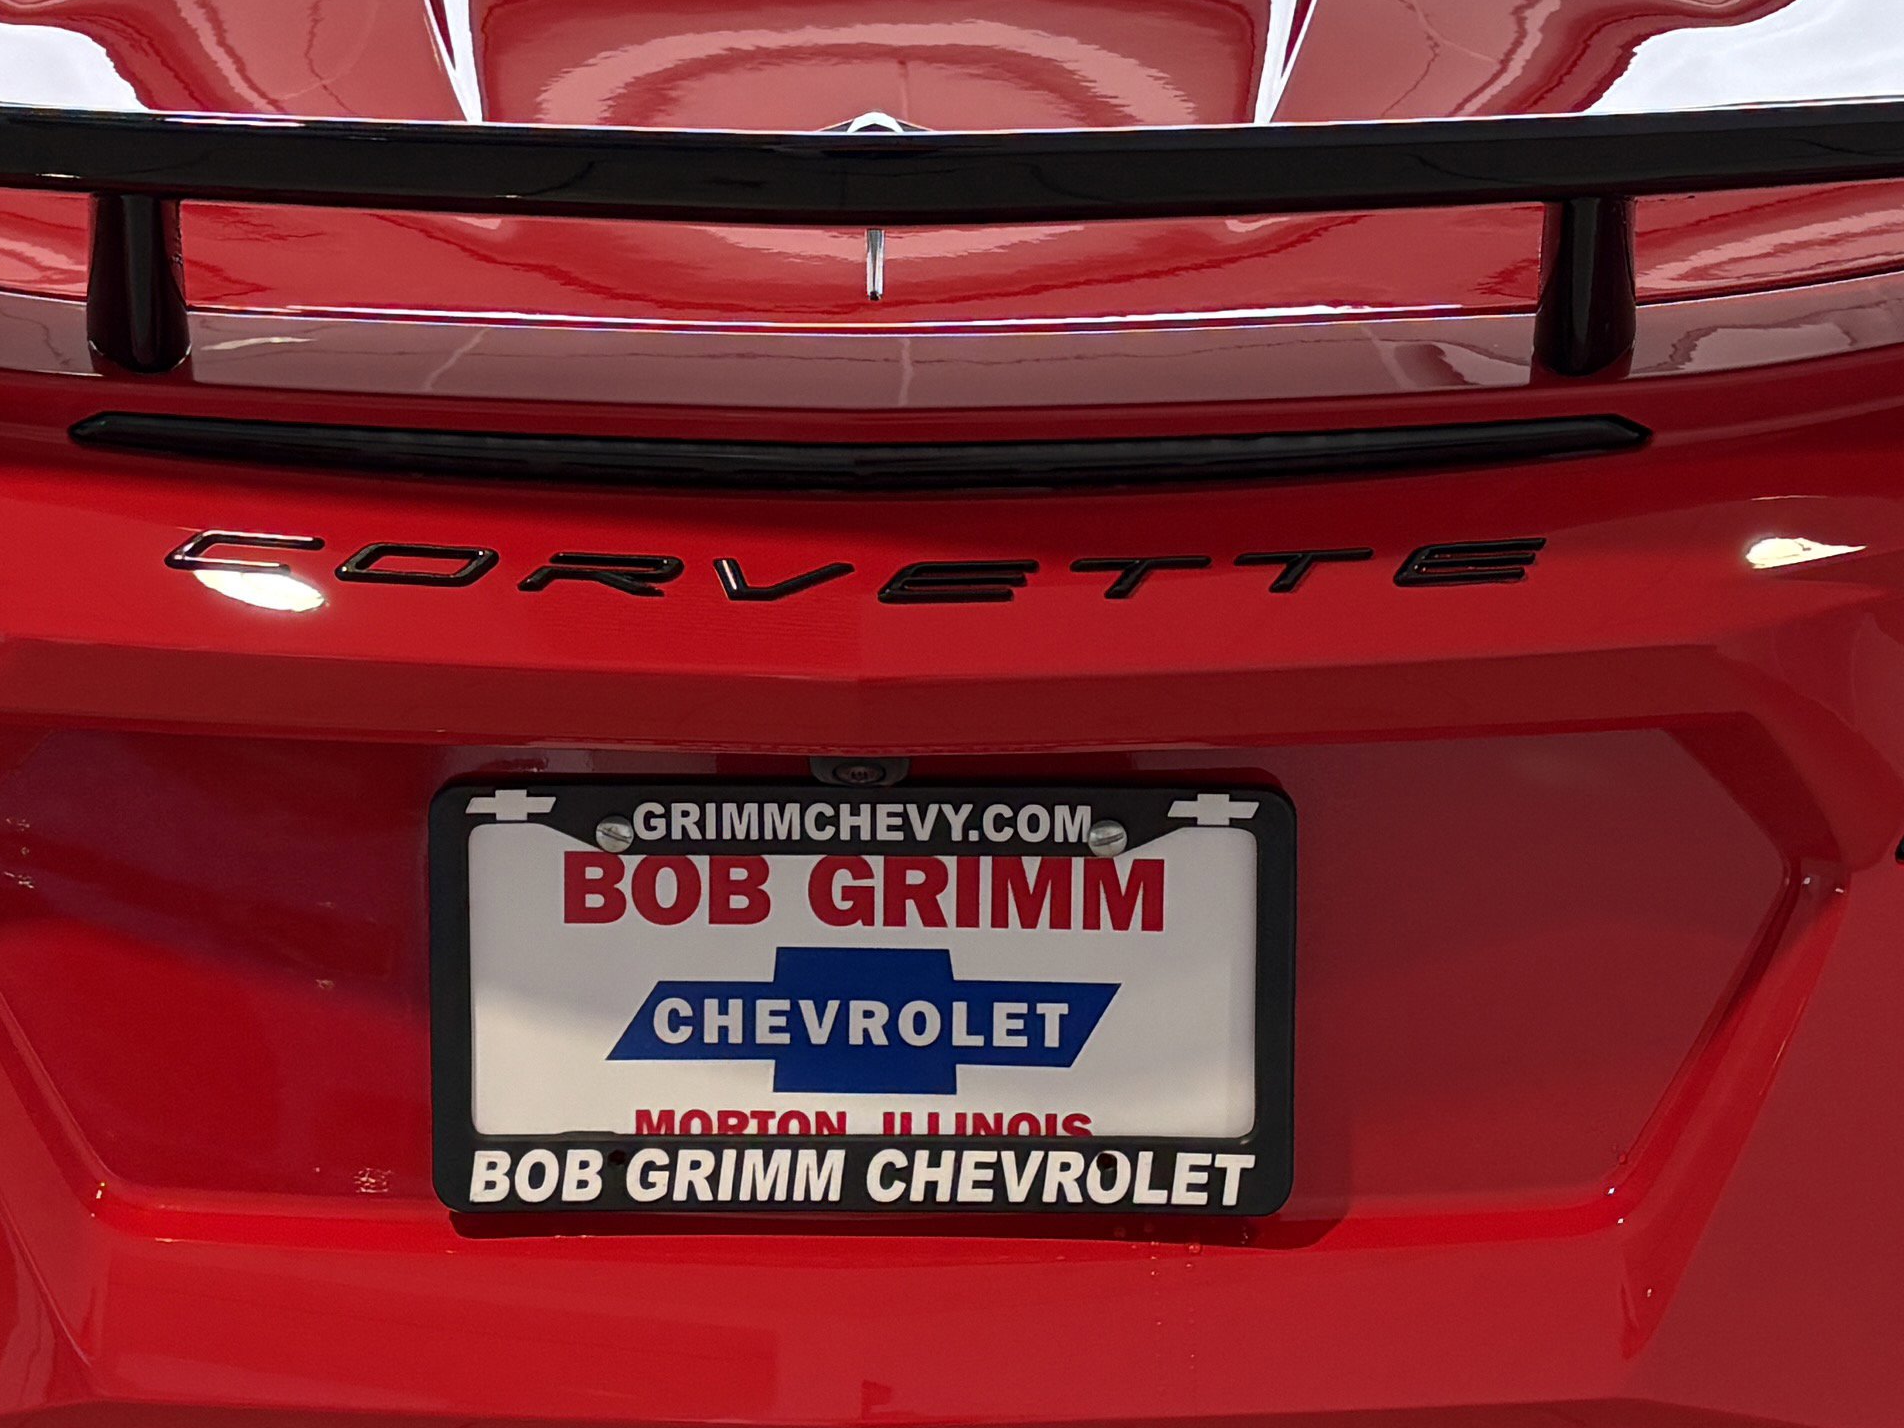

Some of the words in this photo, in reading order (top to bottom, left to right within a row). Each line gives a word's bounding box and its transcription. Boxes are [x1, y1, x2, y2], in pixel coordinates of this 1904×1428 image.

[164, 529, 1546, 603] CORVETTE
[633, 802, 1092, 843] GRIMMCHEVY.COM
[563, 851, 772, 926] BOB
[808, 854, 1165, 932] GRIMM
[652, 997, 1070, 1049] CHEVROLET
[469, 1149, 604, 1203] BOB
[626, 1148, 846, 1203] GRIMM
[866, 1149, 1256, 1206] CHEVROLET
